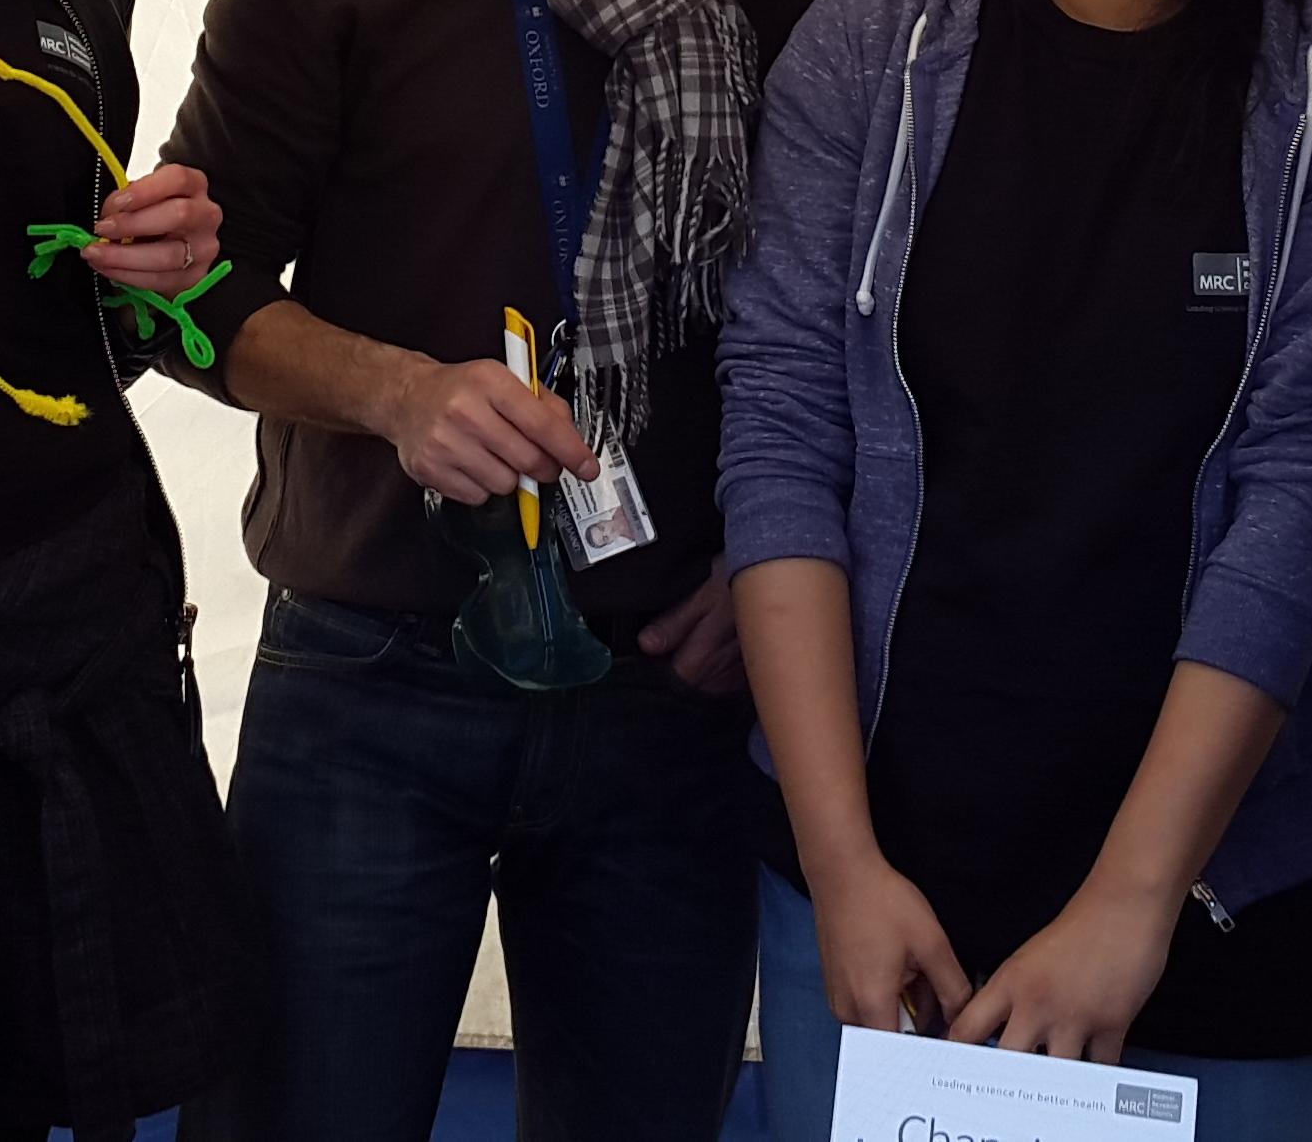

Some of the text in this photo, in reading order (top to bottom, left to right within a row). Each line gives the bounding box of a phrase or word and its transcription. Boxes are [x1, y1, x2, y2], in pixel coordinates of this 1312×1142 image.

[526, 30, 549, 108] OXFORD
[1199, 275, 1235, 290] MRC
[931, 1076, 1107, 1112] Leading science for better health
[1118, 1099, 1145, 1115] MRC
